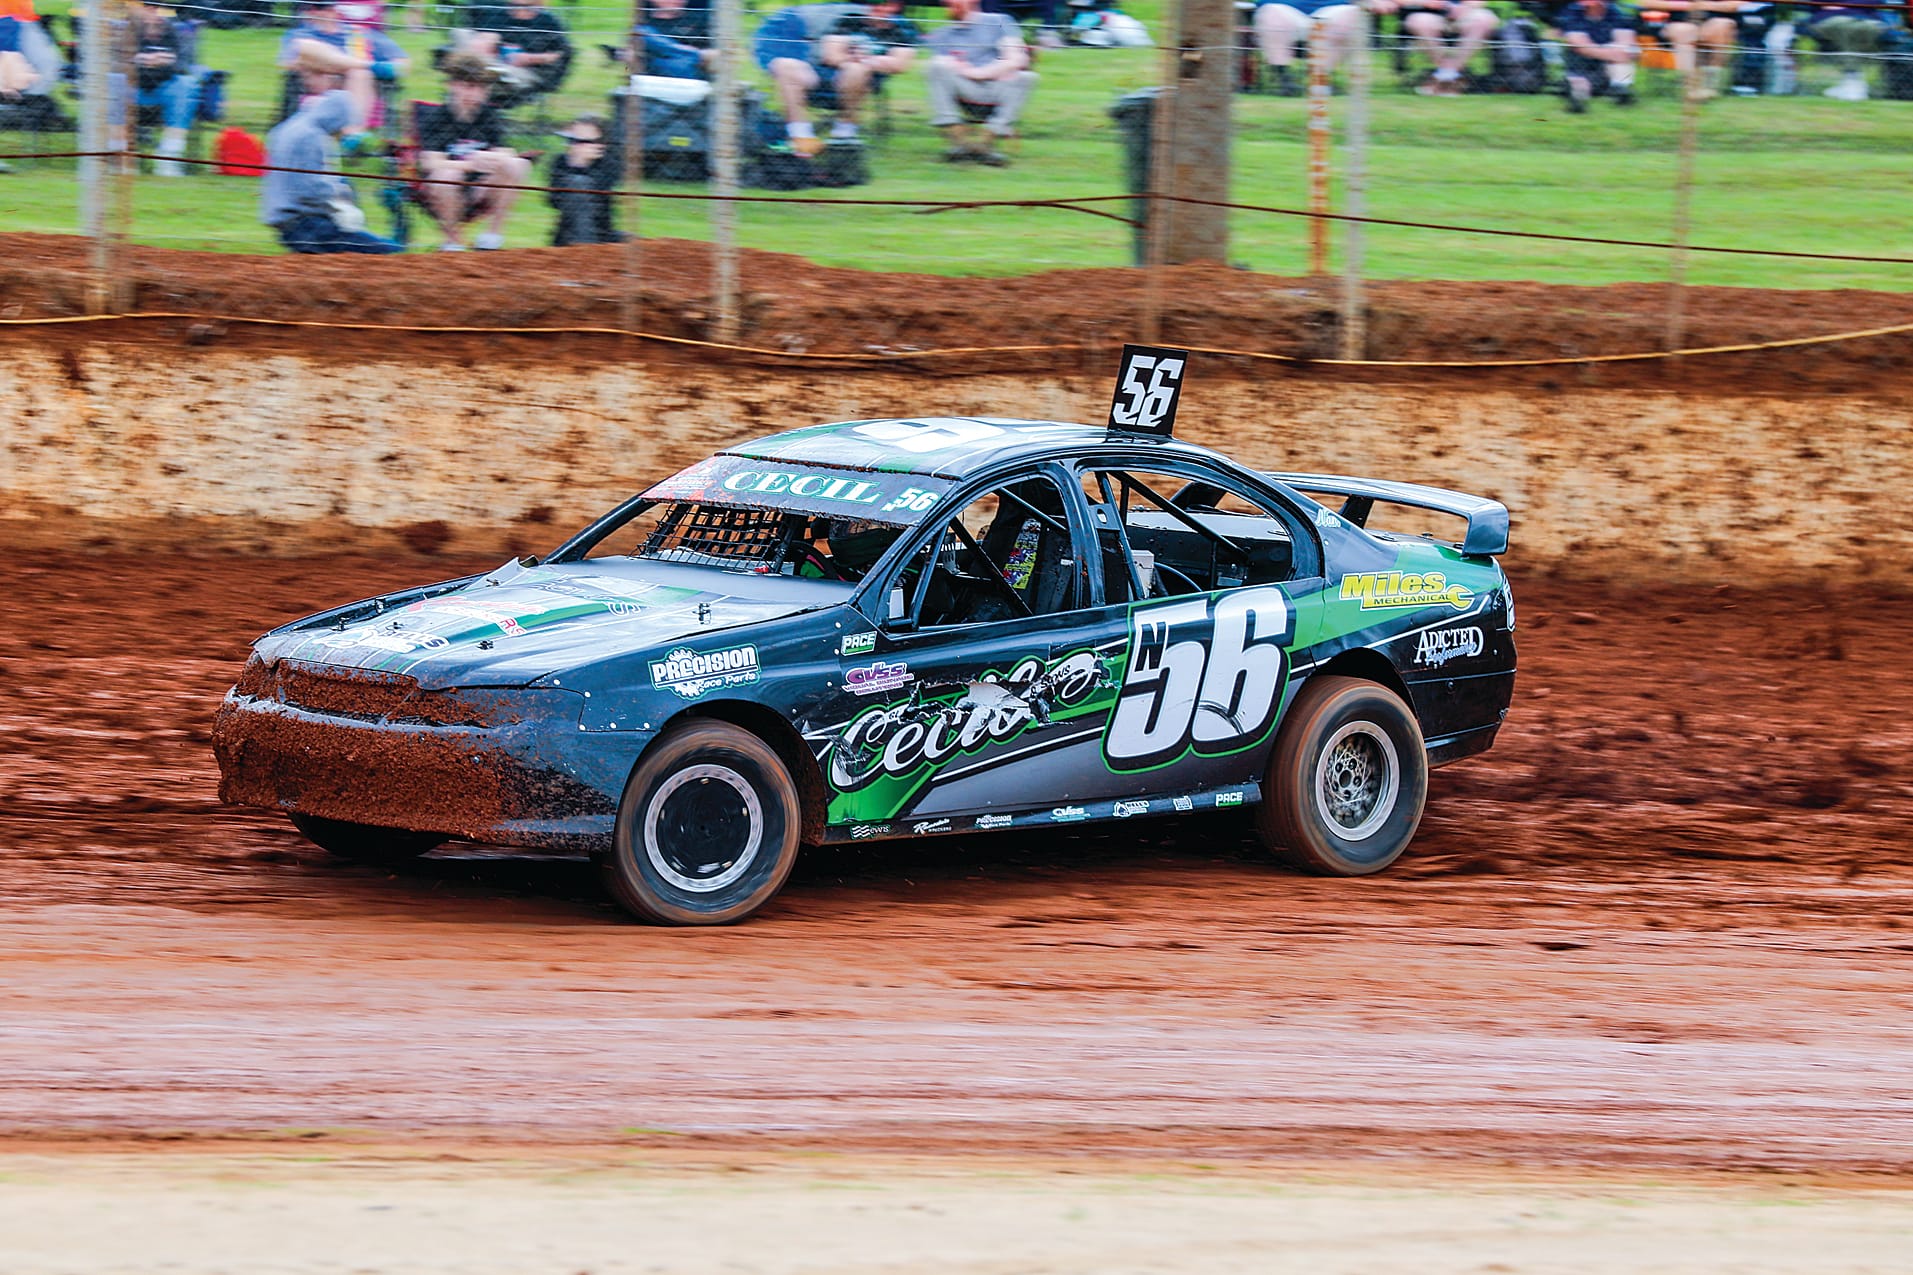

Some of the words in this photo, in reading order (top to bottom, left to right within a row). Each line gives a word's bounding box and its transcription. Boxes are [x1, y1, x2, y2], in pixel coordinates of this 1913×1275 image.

[1112, 354, 1184, 428] 56
[721, 470, 882, 504] CECIL
[895, 486, 940, 511] 56
[1341, 573, 1445, 607] Miles
[843, 633, 876, 653] PACE
[1414, 626, 1484, 663] ADICTED
[652, 647, 756, 682] PRECISION
[1107, 588, 1287, 758] 56
[1216, 792, 1243, 806] PACE
